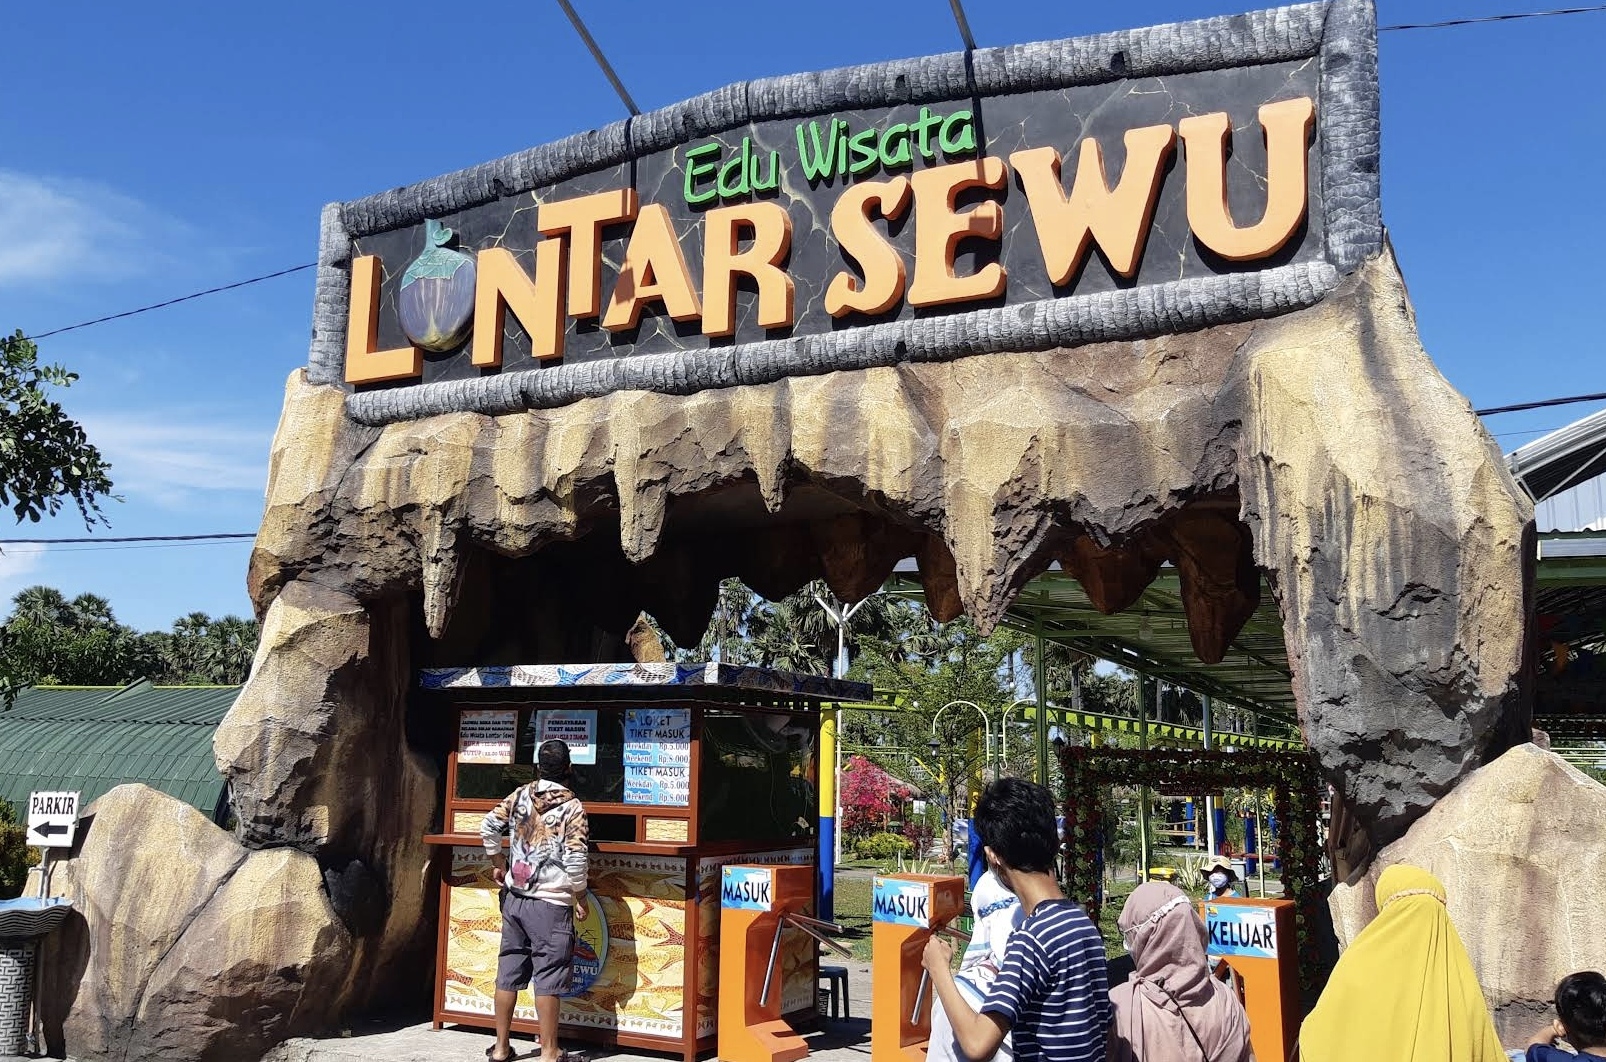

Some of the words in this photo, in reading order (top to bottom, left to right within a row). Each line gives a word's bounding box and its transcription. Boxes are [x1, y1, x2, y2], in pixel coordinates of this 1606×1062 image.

[684, 136, 780, 203] Edu
[796, 107, 976, 181] Wisata
[824, 96, 1316, 318] SEWU
[640, 715, 672, 727] LOKET
[629, 728, 653, 739] TIKET
[654, 728, 686, 739] MASUK
[630, 766, 653, 776] TIKET
[655, 767, 686, 778] MASUK
[32, 797, 75, 815] PARKIR
[722, 880, 770, 903] MASUK
[874, 891, 927, 920] MASUK
[1208, 920, 1274, 949] KELUAR
[573, 965, 598, 975] EWU
